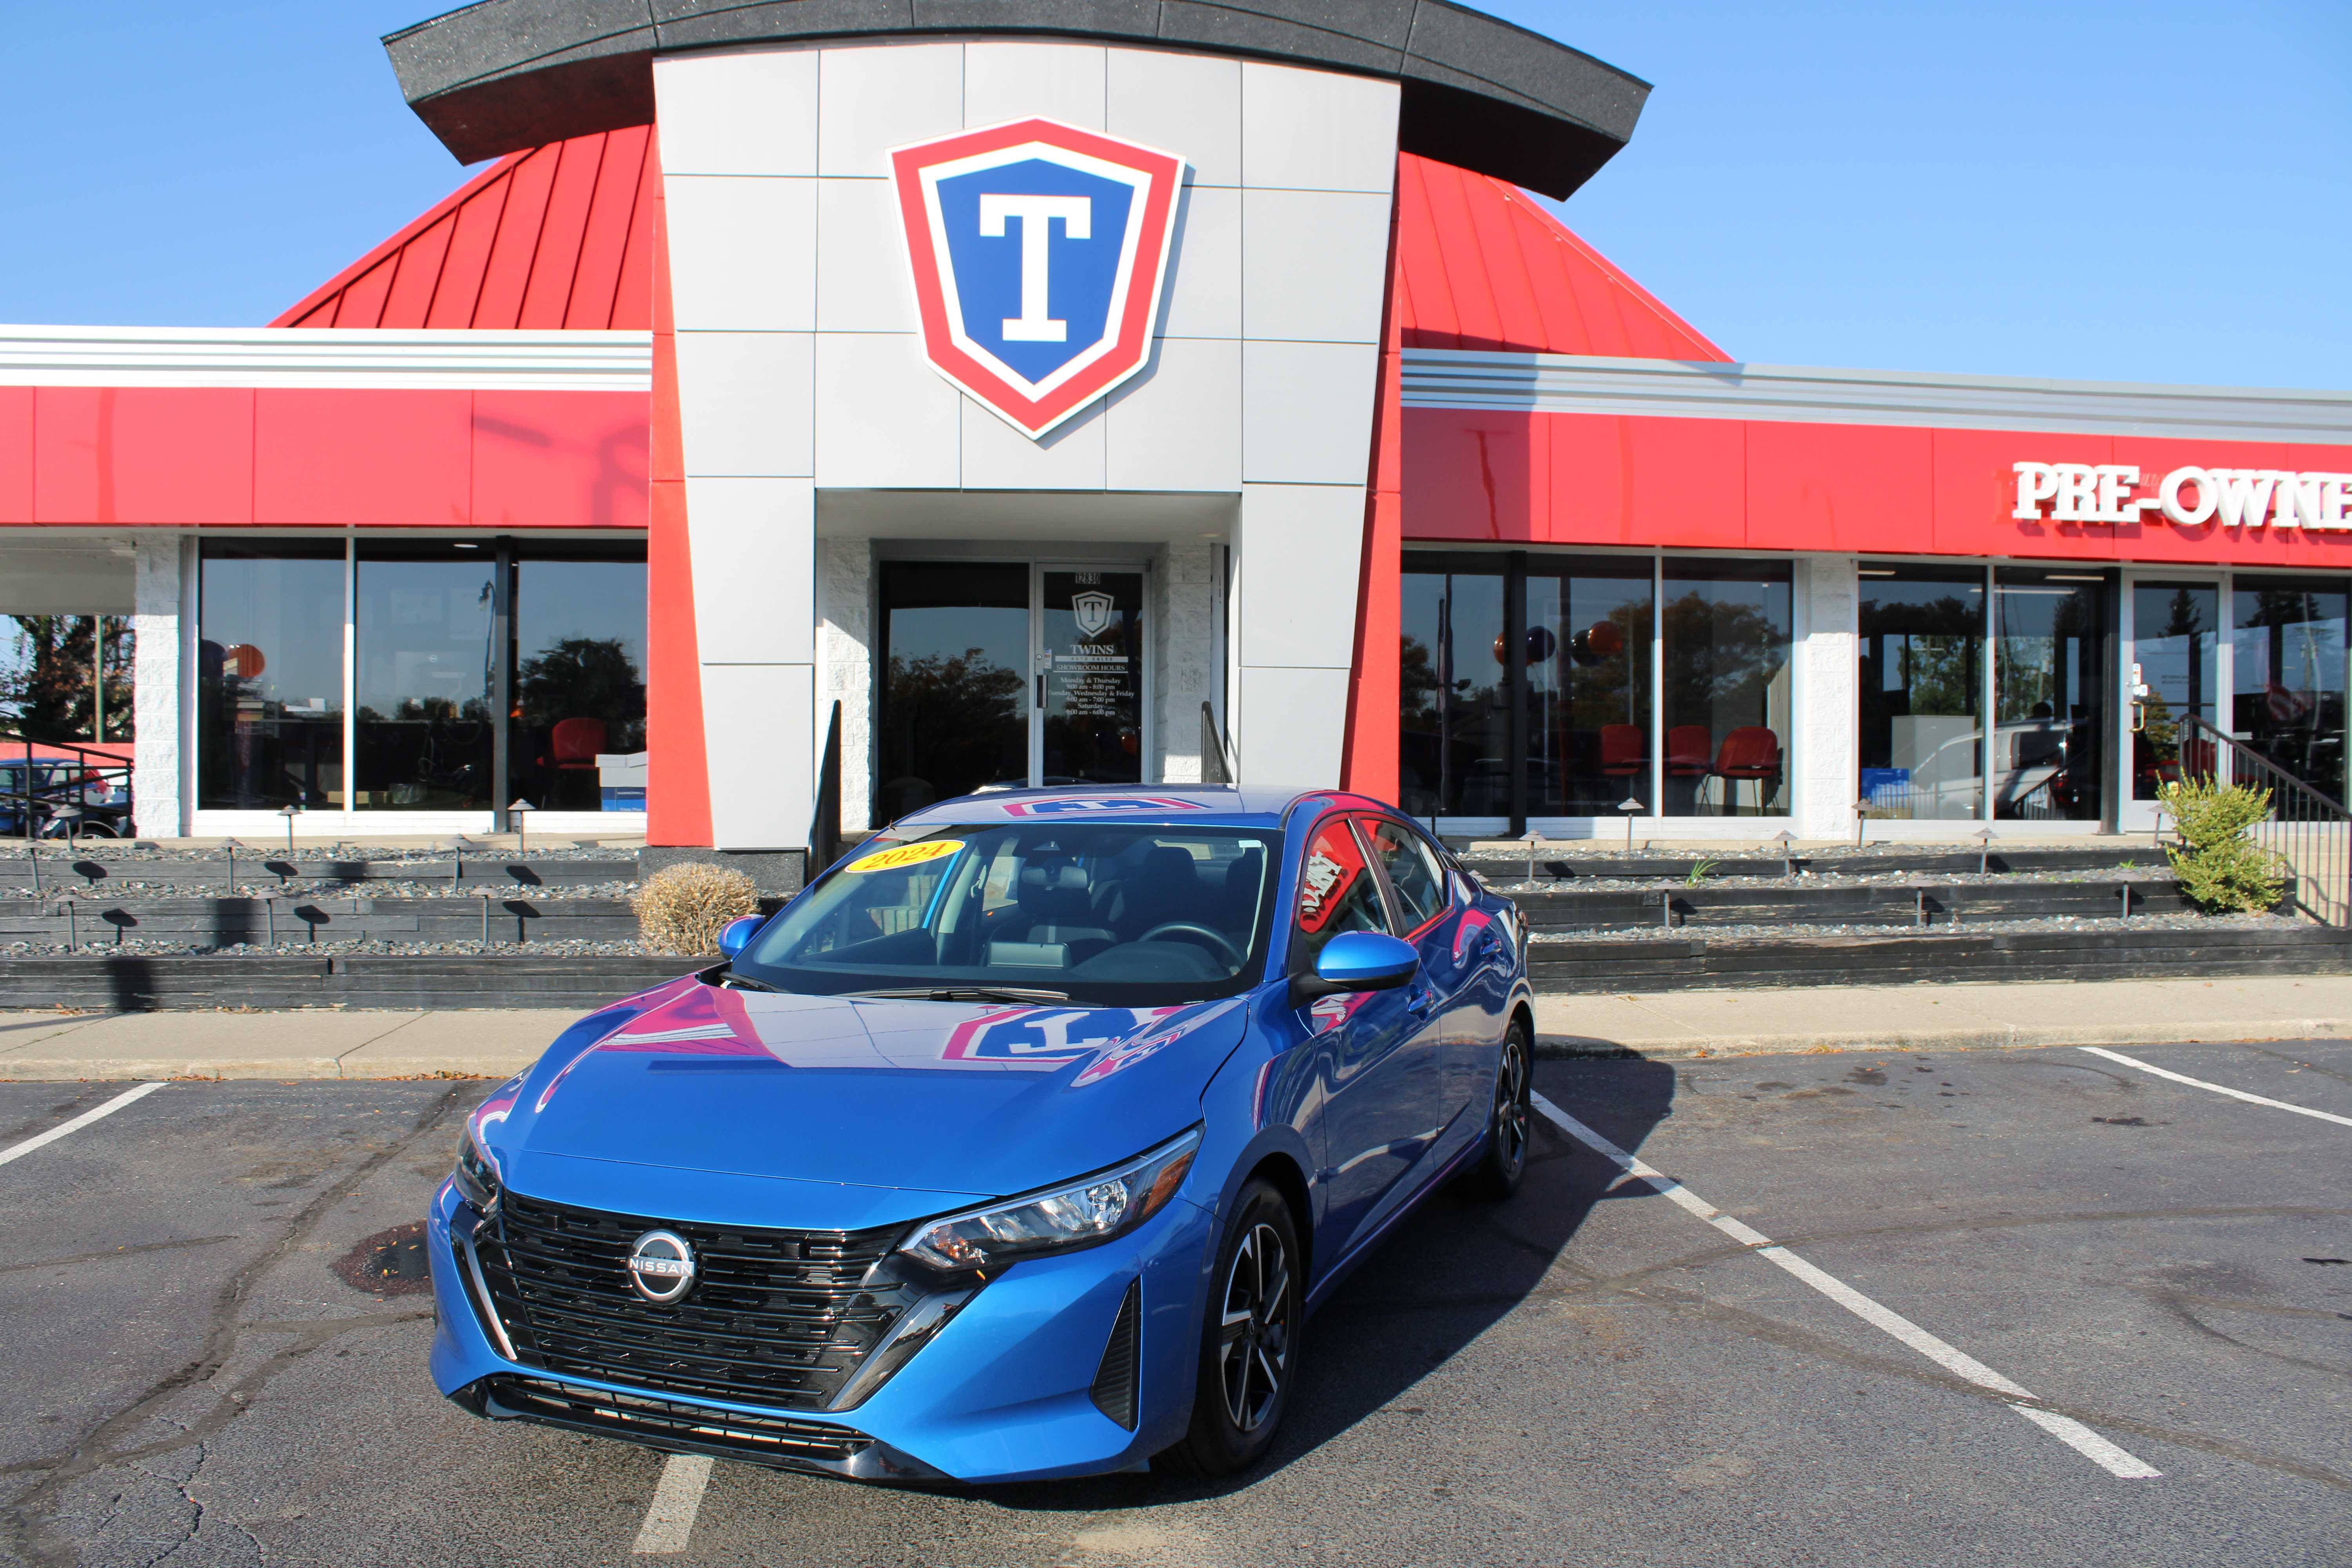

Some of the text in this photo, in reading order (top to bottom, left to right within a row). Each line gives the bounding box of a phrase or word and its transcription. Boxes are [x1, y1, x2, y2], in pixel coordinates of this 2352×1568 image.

[980, 194, 1091, 342] T
[1076, 573, 1100, 583] 12830
[1084, 602, 1102, 622] T
[1070, 644, 1114, 654] TWINS
[862, 843, 947, 869] 2024
[629, 1258, 692, 1274] NISSAN
